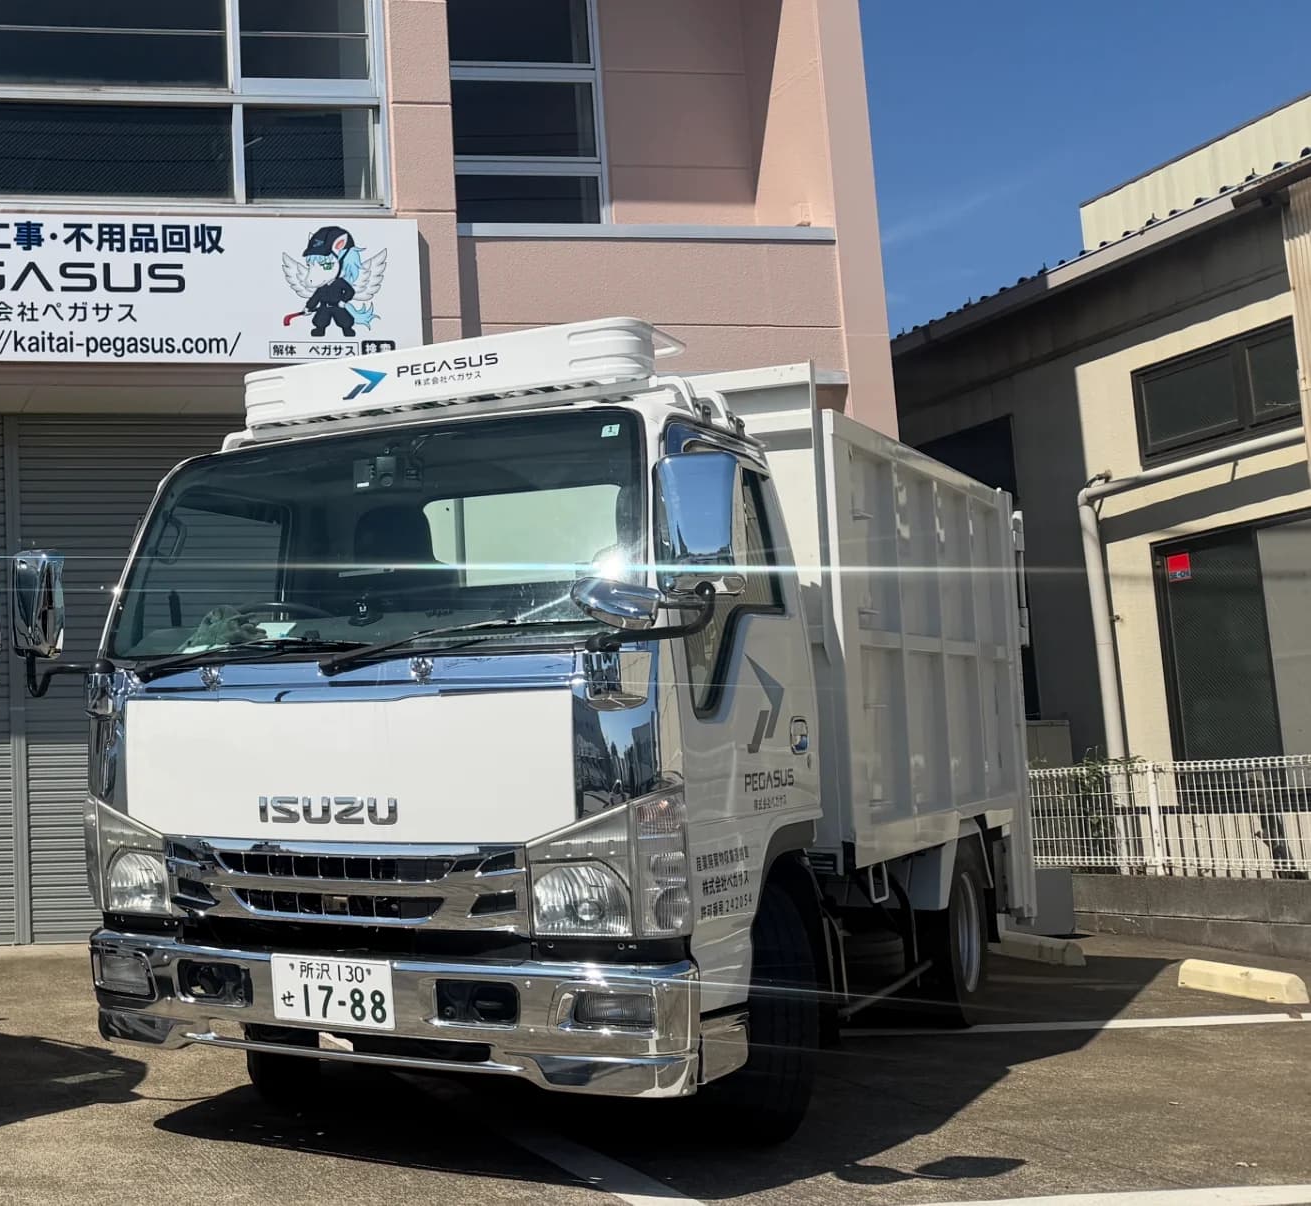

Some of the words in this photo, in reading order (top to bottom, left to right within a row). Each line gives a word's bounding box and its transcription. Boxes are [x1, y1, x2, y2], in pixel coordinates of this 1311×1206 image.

[397, 352, 499, 378] PEGASUS
[414, 370, 482, 387] 株式会社ペガサス
[744, 768, 795, 793] PEGASUS
[258, 795, 399, 826] ISUZU
[702, 870, 749, 897] 株式会社ペガサス
[300, 961, 332, 980] 所沢
[337, 964, 365, 983] 130
[281, 990, 295, 1008] せ
[303, 984, 388, 1024] 17-88
